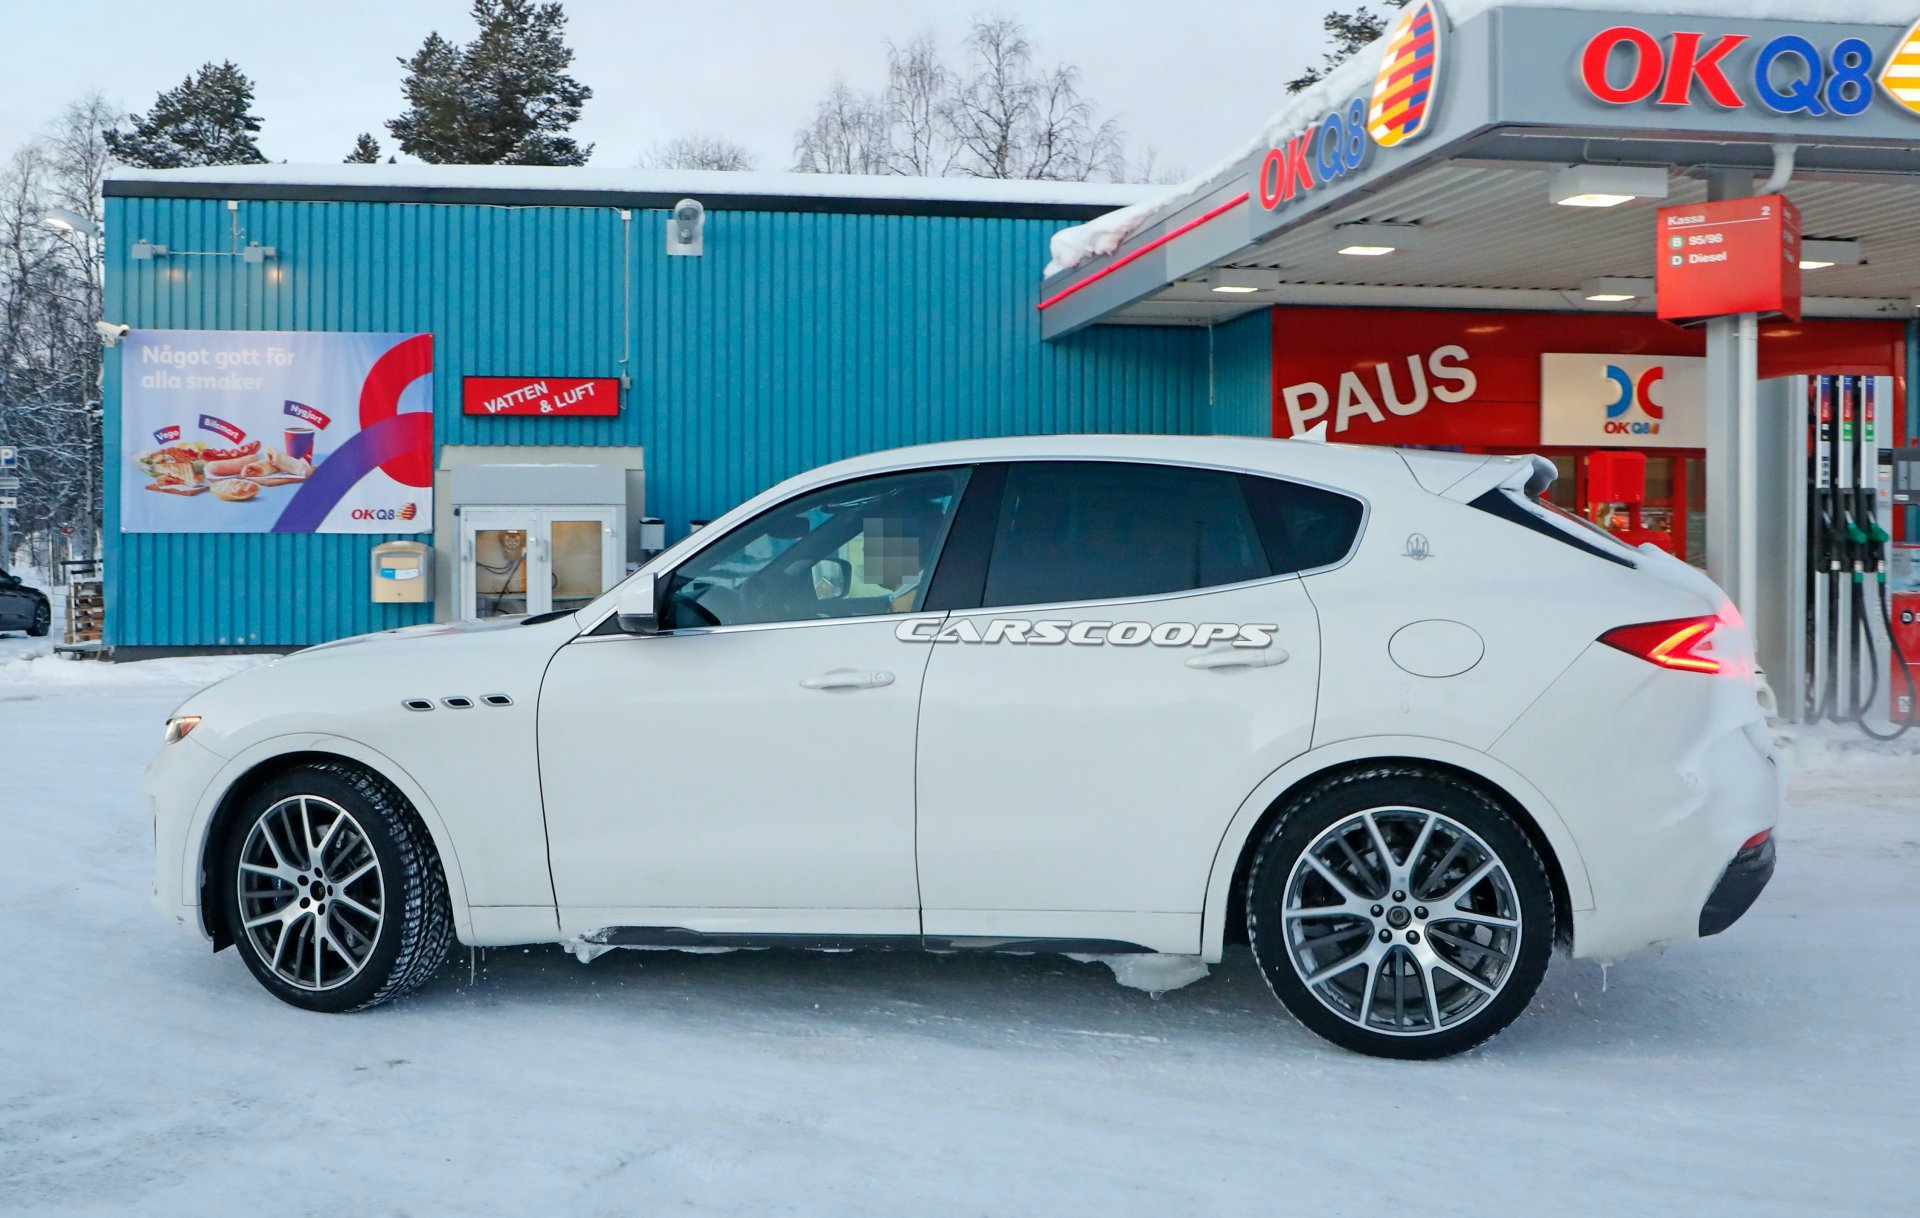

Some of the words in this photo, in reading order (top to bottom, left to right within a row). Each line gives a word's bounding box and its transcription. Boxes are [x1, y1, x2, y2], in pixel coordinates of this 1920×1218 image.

[1667, 215, 1705, 225] Kassa
[1761, 206, 1771, 216] 2
[1671, 255, 1683, 265] D
[1689, 251, 1727, 264] Diesel
[142, 345, 209, 369] Något
[215, 349, 260, 370] gott
[265, 347, 296, 366] för
[142, 372, 181, 389] alla
[186, 372, 264, 390] smaker
[1282, 345, 1478, 437] PAUS
[483, 381, 549, 414] VATTEN
[539, 400, 554, 414] &
[554, 382, 595, 408] LUFT
[290, 404, 323, 424] Nygjort
[156, 429, 180, 441] Vego
[203, 418, 240, 440] Bilsmart
[1, 448, 13, 466] P
